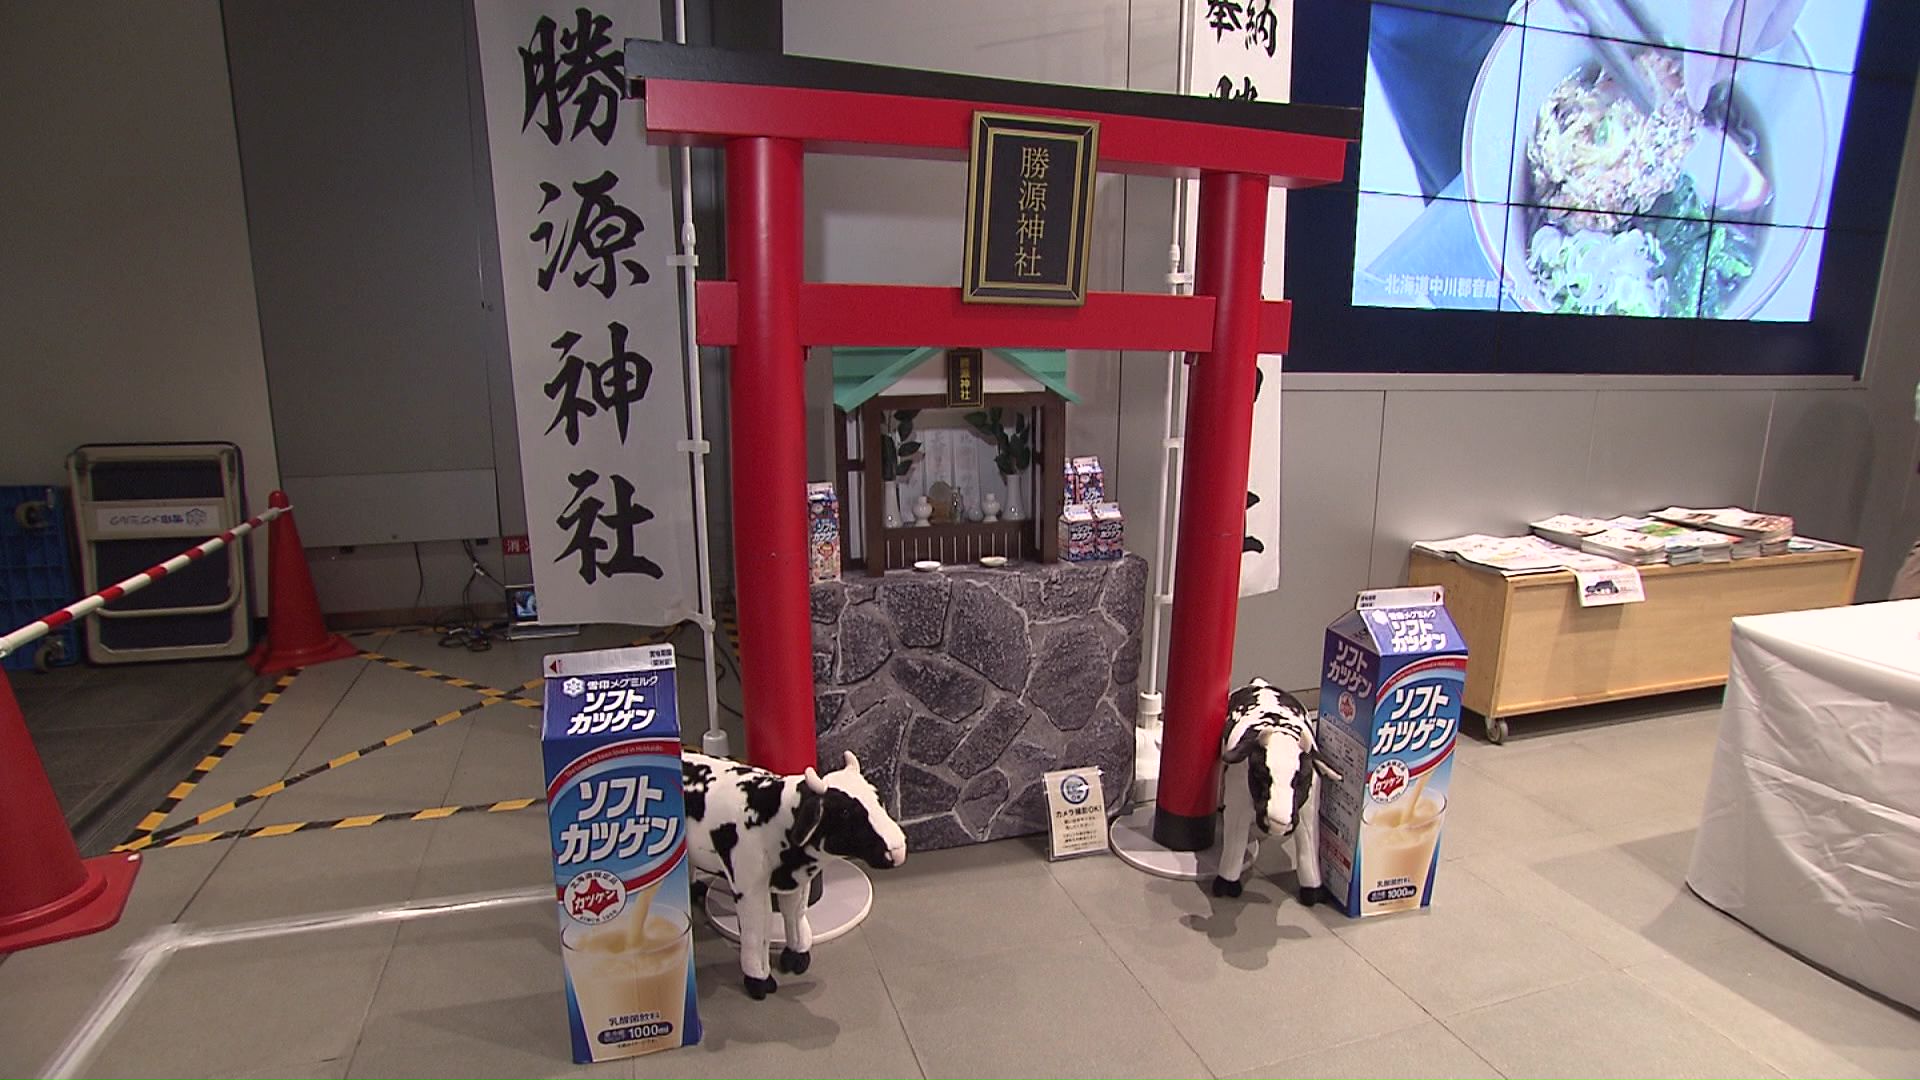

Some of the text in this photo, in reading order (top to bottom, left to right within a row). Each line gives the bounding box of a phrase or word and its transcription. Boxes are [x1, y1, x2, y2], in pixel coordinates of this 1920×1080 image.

[1013, 146, 1051, 278] 勝源神社
[518, 6, 665, 586] 勝源神社
[1391, 619, 1433, 638] ソフト
[1391, 633, 1446, 653] カツゲン
[1335, 640, 1368, 672] ソフト
[1327, 660, 1373, 699] カツゲン
[583, 688, 645, 713] ソフト
[1390, 684, 1450, 721] ソフト
[567, 708, 656, 736] カツゲン
[1371, 716, 1457, 756] カツゲン
[578, 775, 664, 822] ソフト
[557, 816, 679, 866] カツゲン
